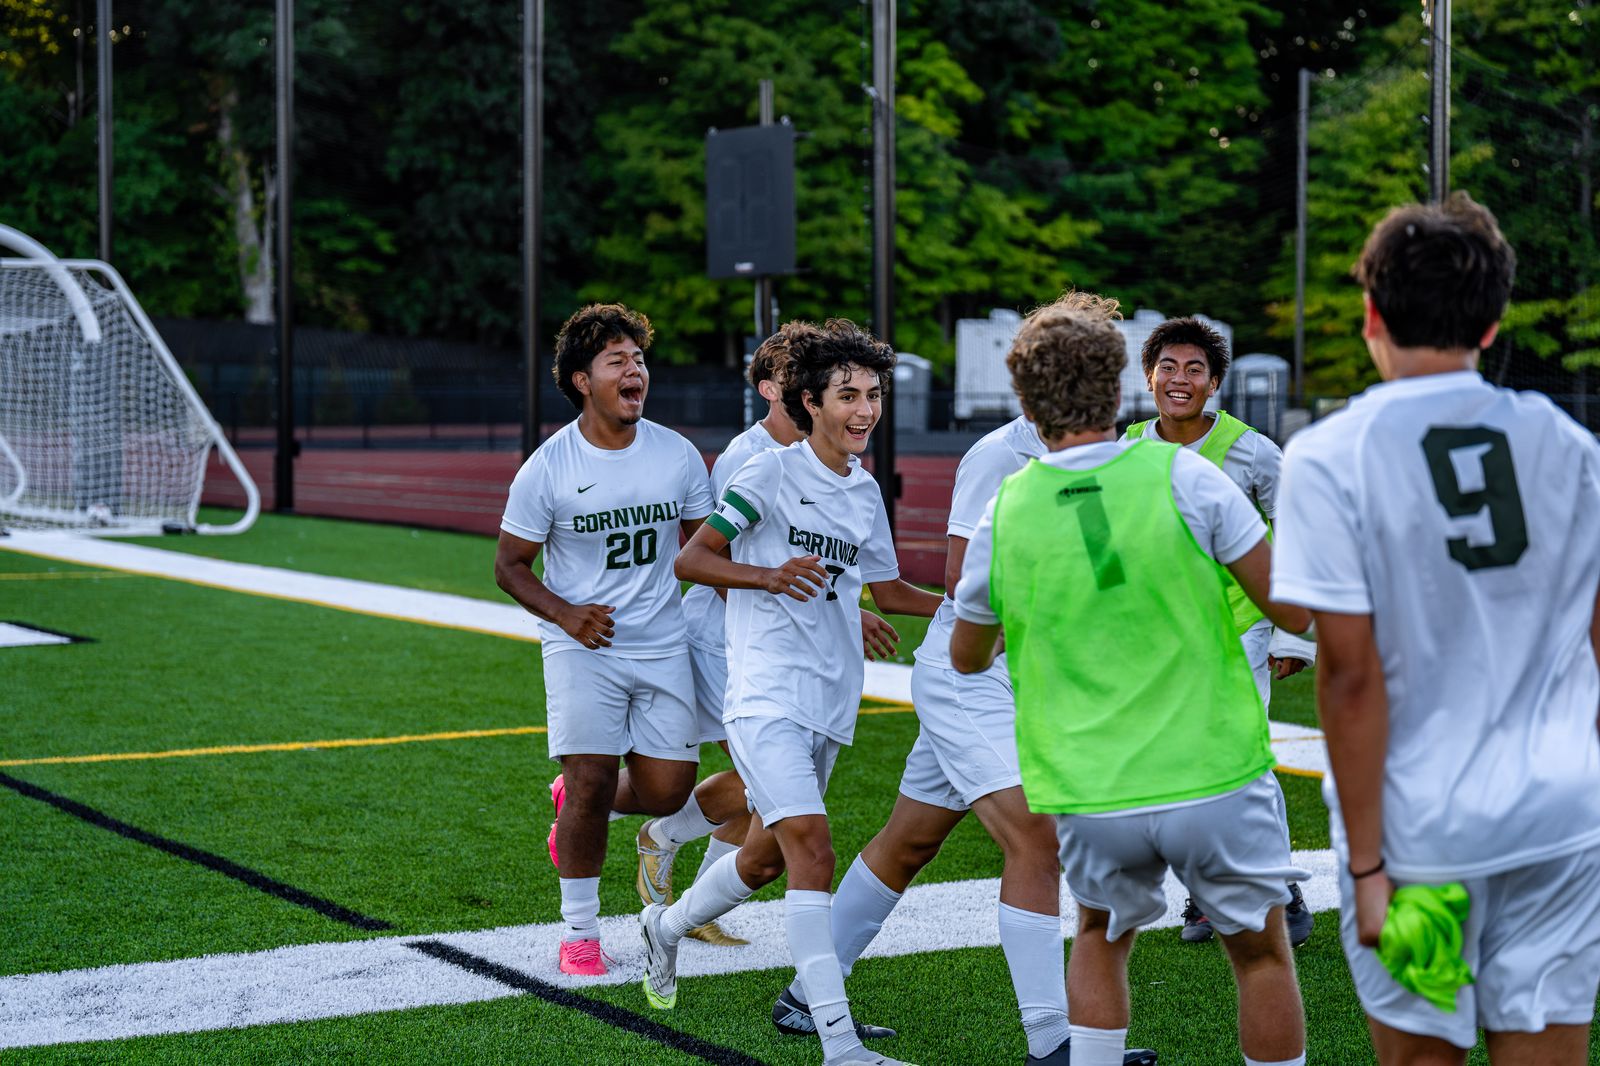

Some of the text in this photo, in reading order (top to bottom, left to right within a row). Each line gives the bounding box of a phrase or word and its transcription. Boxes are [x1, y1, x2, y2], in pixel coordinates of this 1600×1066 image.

[573, 501, 679, 533] CORNWALL
[1420, 424, 1529, 572] 9
[606, 528, 657, 570] 20
[788, 526, 859, 567] CORNWA
